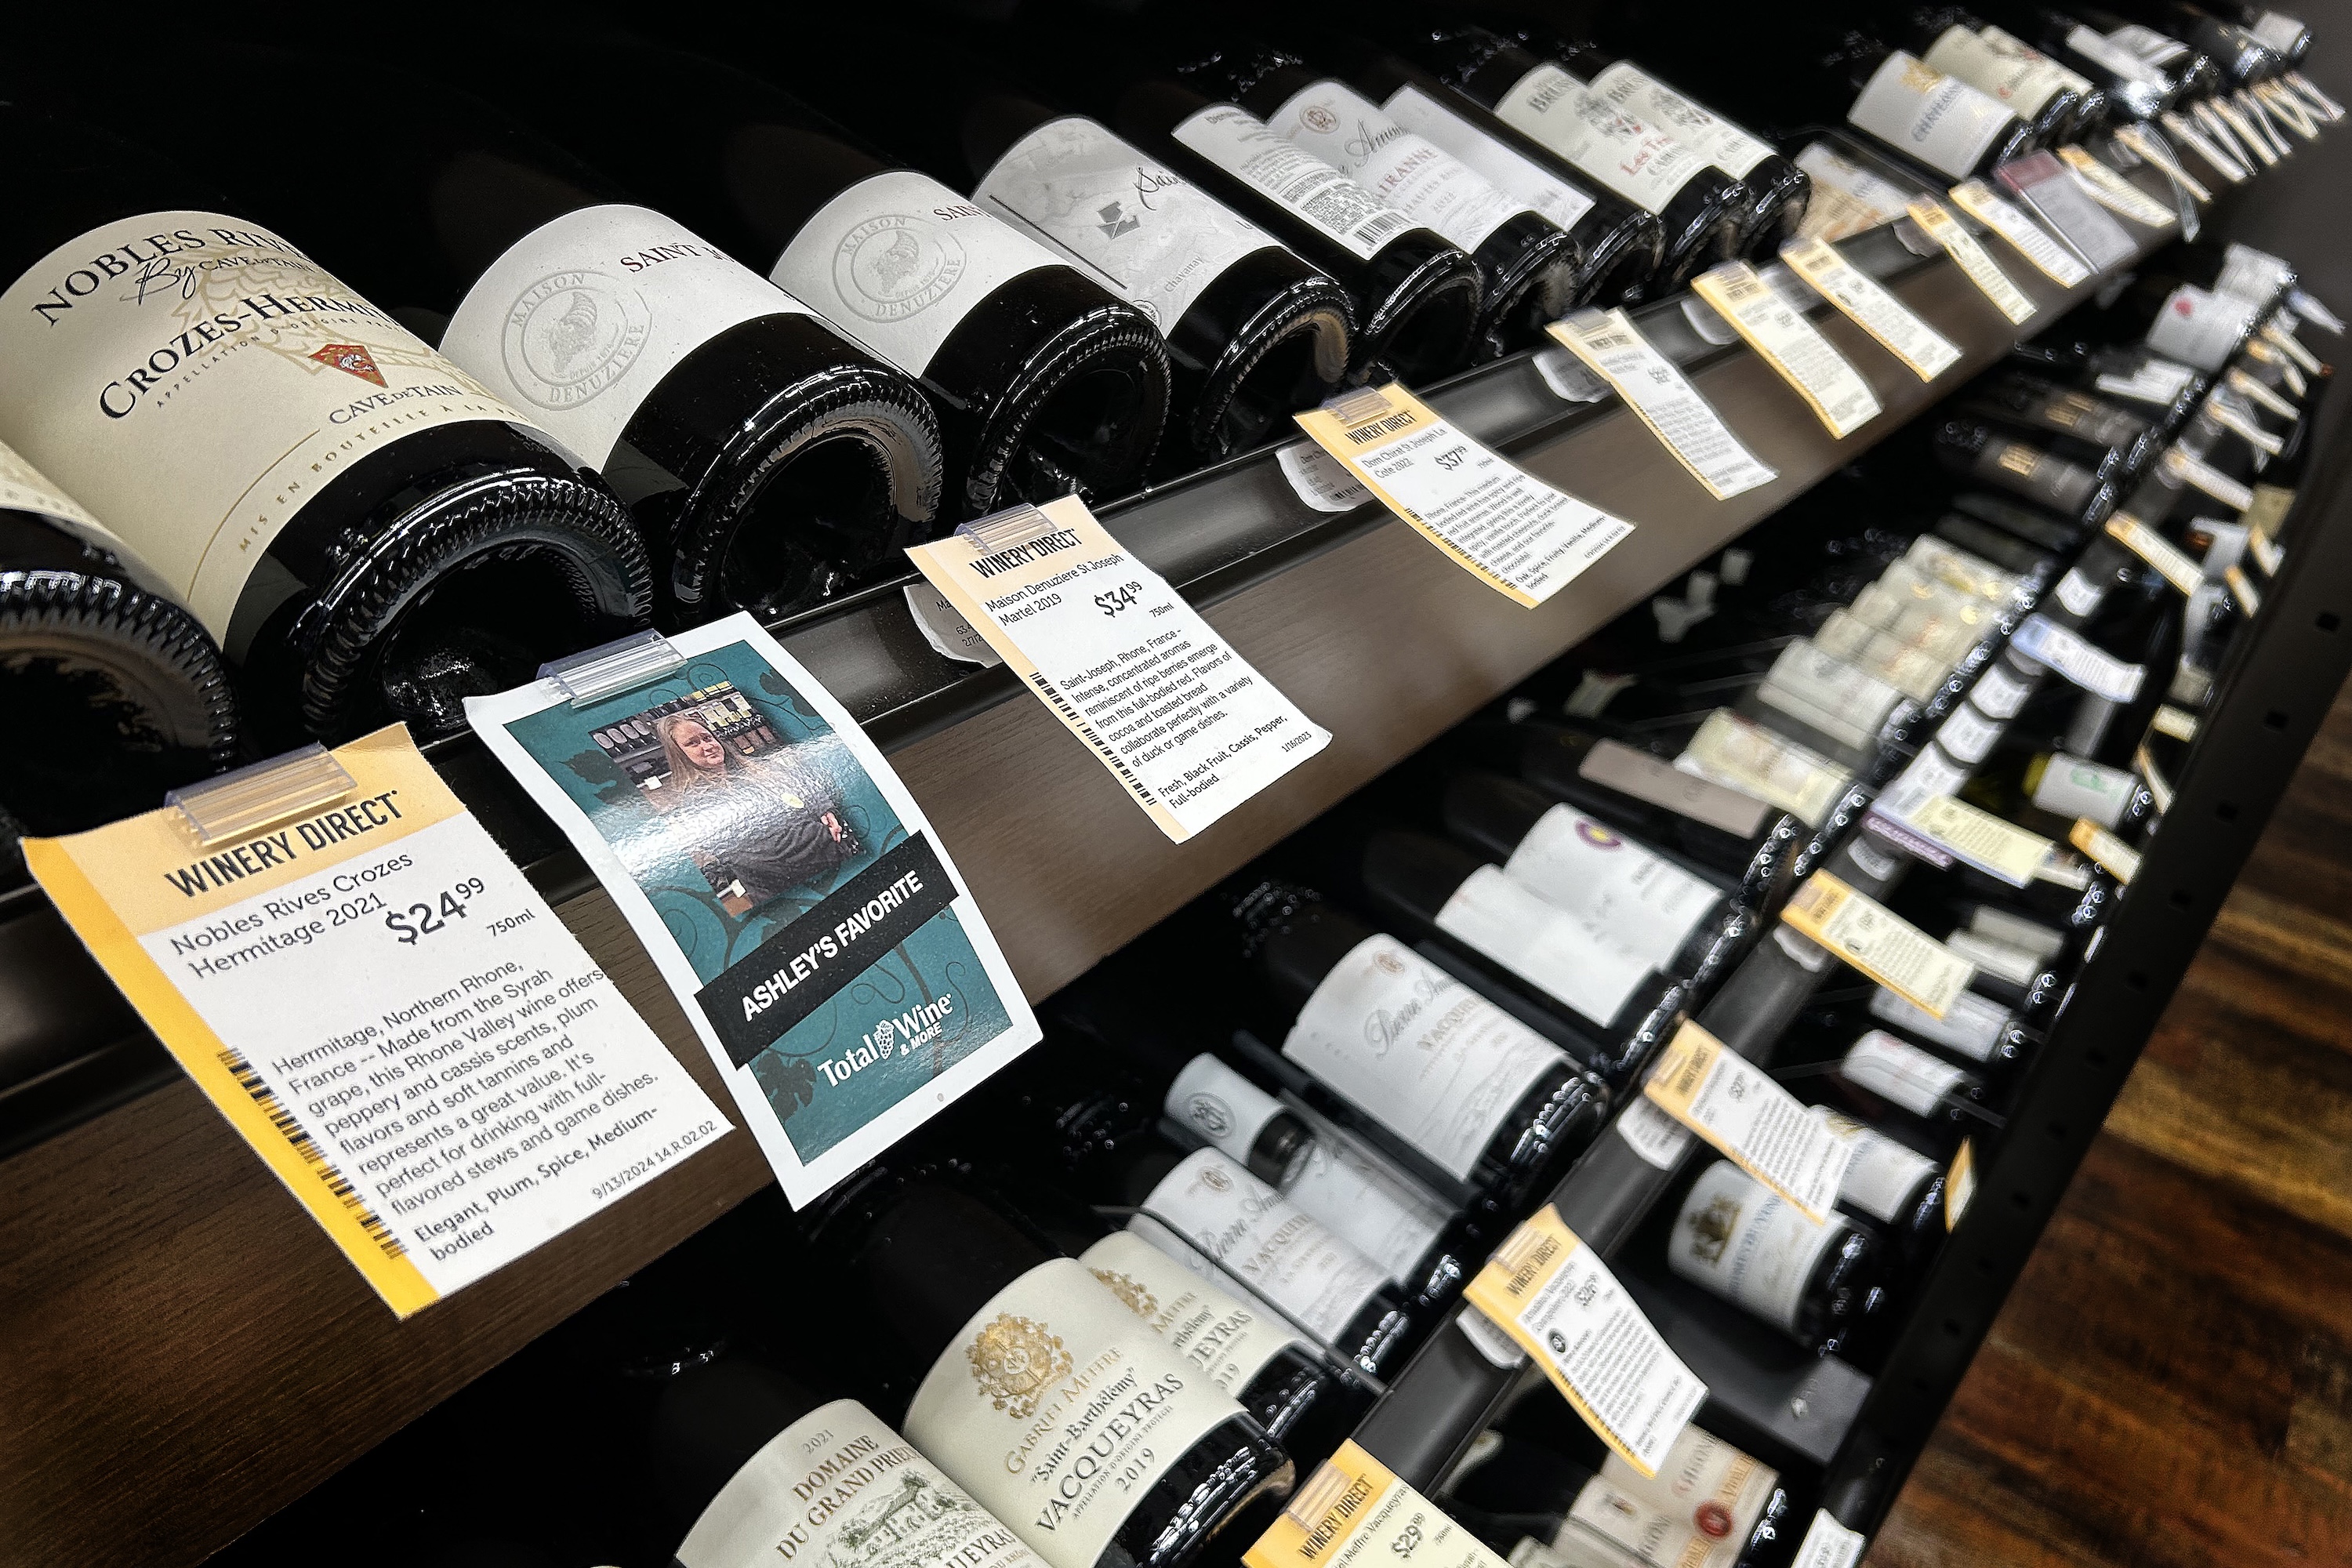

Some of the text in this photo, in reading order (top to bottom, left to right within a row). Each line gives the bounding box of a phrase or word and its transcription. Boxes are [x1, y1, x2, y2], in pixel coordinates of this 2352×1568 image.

[620, 243, 702, 273] SAINT
[841, 217, 906, 256] MAISON
[32, 230, 206, 326] NOBLES
[119, 257, 197, 306] By
[511, 274, 584, 328] MAISON
[876, 258, 961, 316] DENUZIERE
[157, 336, 260, 408] APPELLATION
[550, 324, 644, 403] DENUZIERE
[329, 384, 463, 424] CAVE TAIN
[1345, 410, 1417, 445] WINERY DIRECT
[1409, 431, 1439, 449] Joseph
[239, 514, 268, 552] MIS
[276, 481, 300, 505] EN
[311, 408, 430, 473] BOUTEILLE
[968, 528, 1082, 579] WINERY DIRECT
[985, 554, 1125, 612] Maison Denuziere St Joseph
[998, 593, 1062, 626] Martel 2019
[1149, 602, 1174, 618] 750ml
[1060, 629, 1178, 691] Saint-Joseph, Rhone, France
[1071, 640, 1192, 704] Intense, concentrated aromas
[1084, 643, 1218, 717] reminiscent of ripe berries emerge
[1094, 650, 1233, 730] from this full-bodied red. Flavors of
[1108, 683, 1209, 742] cocoa and toasted bread
[1120, 724, 1167, 755] collaborate
[1166, 704, 1203, 732] perfectly
[1200, 695, 1221, 710] with
[1225, 676, 1254, 695] variety
[1132, 710, 1229, 768] of duck or game dishes.
[1281, 731, 1312, 753] 1/16/2023
[1157, 716, 1288, 797] Fresh, Black Fruit, Cassis, Pepper,
[1169, 773, 1220, 809] Full-bodied
[164, 797, 402, 898] WINERY DIRECT
[170, 854, 413, 956] Nobles Rives Crozes
[188, 892, 388, 979] Hermitage 2021
[487, 908, 535, 938] 750ml
[740, 870, 924, 1022] ASHLEY'S FAVORITE
[383, 988, 461, 1029] Northern
[460, 961, 524, 993] Rhone,
[289, 1061, 358, 1095] France
[377, 1027, 431, 1058] Made
[430, 1007, 474, 1033] from
[473, 994, 504, 1013] the
[503, 968, 554, 998] Syrah
[308, 968, 604, 1118] grape, this Rhone Valley wine offers
[817, 993, 953, 1087] Total Wine
[899, 1023, 942, 1055] & MORE
[324, 996, 599, 1138] peppery and cassis scents, plum
[339, 1034, 574, 1156] flavors and soft tannins and
[358, 1052, 595, 1175] represents a great value. It's
[376, 1072, 606, 1199] perfect for drinking with full-
[391, 1073, 659, 1215] flavored stews and game dishes.
[414, 1108, 659, 1243] Elegant, Plum, Spice, Medium-
[591, 1157, 655, 1200] 9/13/2024
[429, 1221, 495, 1261] bodied
[791, 1435, 879, 1501] DOMAINE
[803, 1430, 834, 1454] 2021
[1034, 1372, 1184, 1532] VACQUEYRAS
[1117, 1447, 1156, 1494] 2019
[775, 1467, 875, 1561] DU GRAND
[1073, 1473, 1111, 1519] APPELLATION
[1298, 1473, 1374, 1561] WINERY DIRECT
